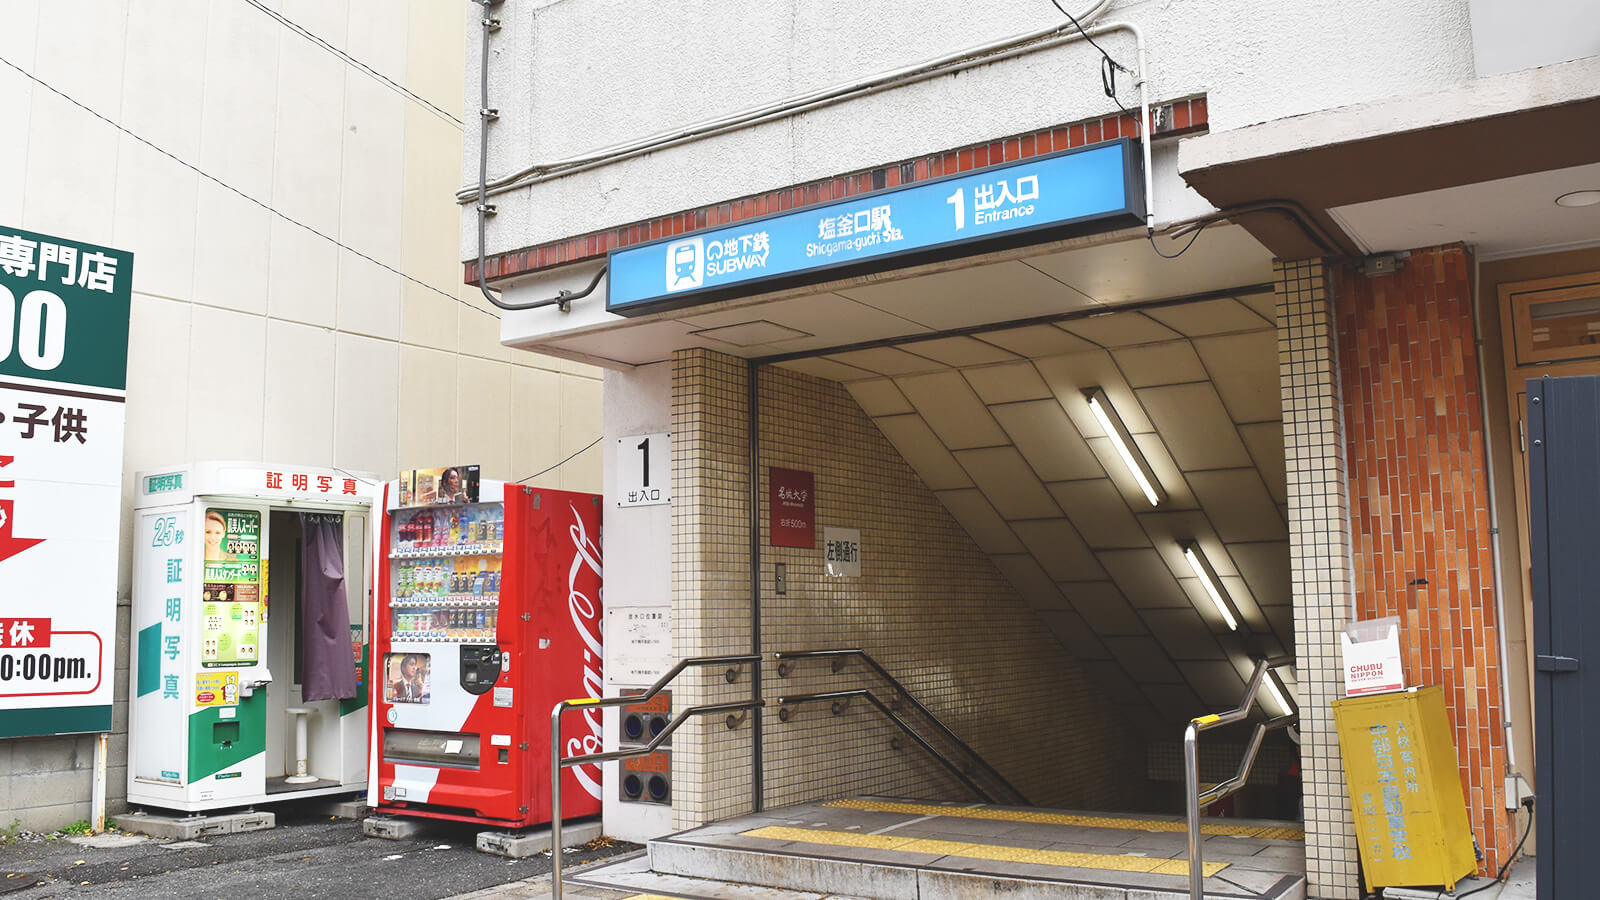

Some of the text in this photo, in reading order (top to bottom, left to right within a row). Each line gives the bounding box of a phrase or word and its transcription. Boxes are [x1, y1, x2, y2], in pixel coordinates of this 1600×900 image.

[946, 174, 1040, 232] 1 出入口
[974, 204, 1036, 225] Entrance
[817, 204, 893, 240] 塩釜口駅
[723, 231, 771, 257] 地下鉄
[806, 226, 904, 258] Shiogama-guchi Sta.
[0, 234, 118, 294] 専門店
[706, 251, 769, 278] SUBWAY
[637, 437, 650, 488] 1
[148, 473, 183, 493] 証明写真
[266, 471, 358, 496] 証明写真
[628, 489, 660, 503] 出入口
[826, 540, 858, 562] 左側通行
[0, 620, 35, 646] 休
[163, 558, 183, 701] 証明写真
[1350, 662, 1383, 673] CHUBU
[1350, 671, 1384, 679] NIPPON
[1395, 720, 1419, 793] 入校案内所
[1369, 722, 1414, 861] 中部日本自動車学校
